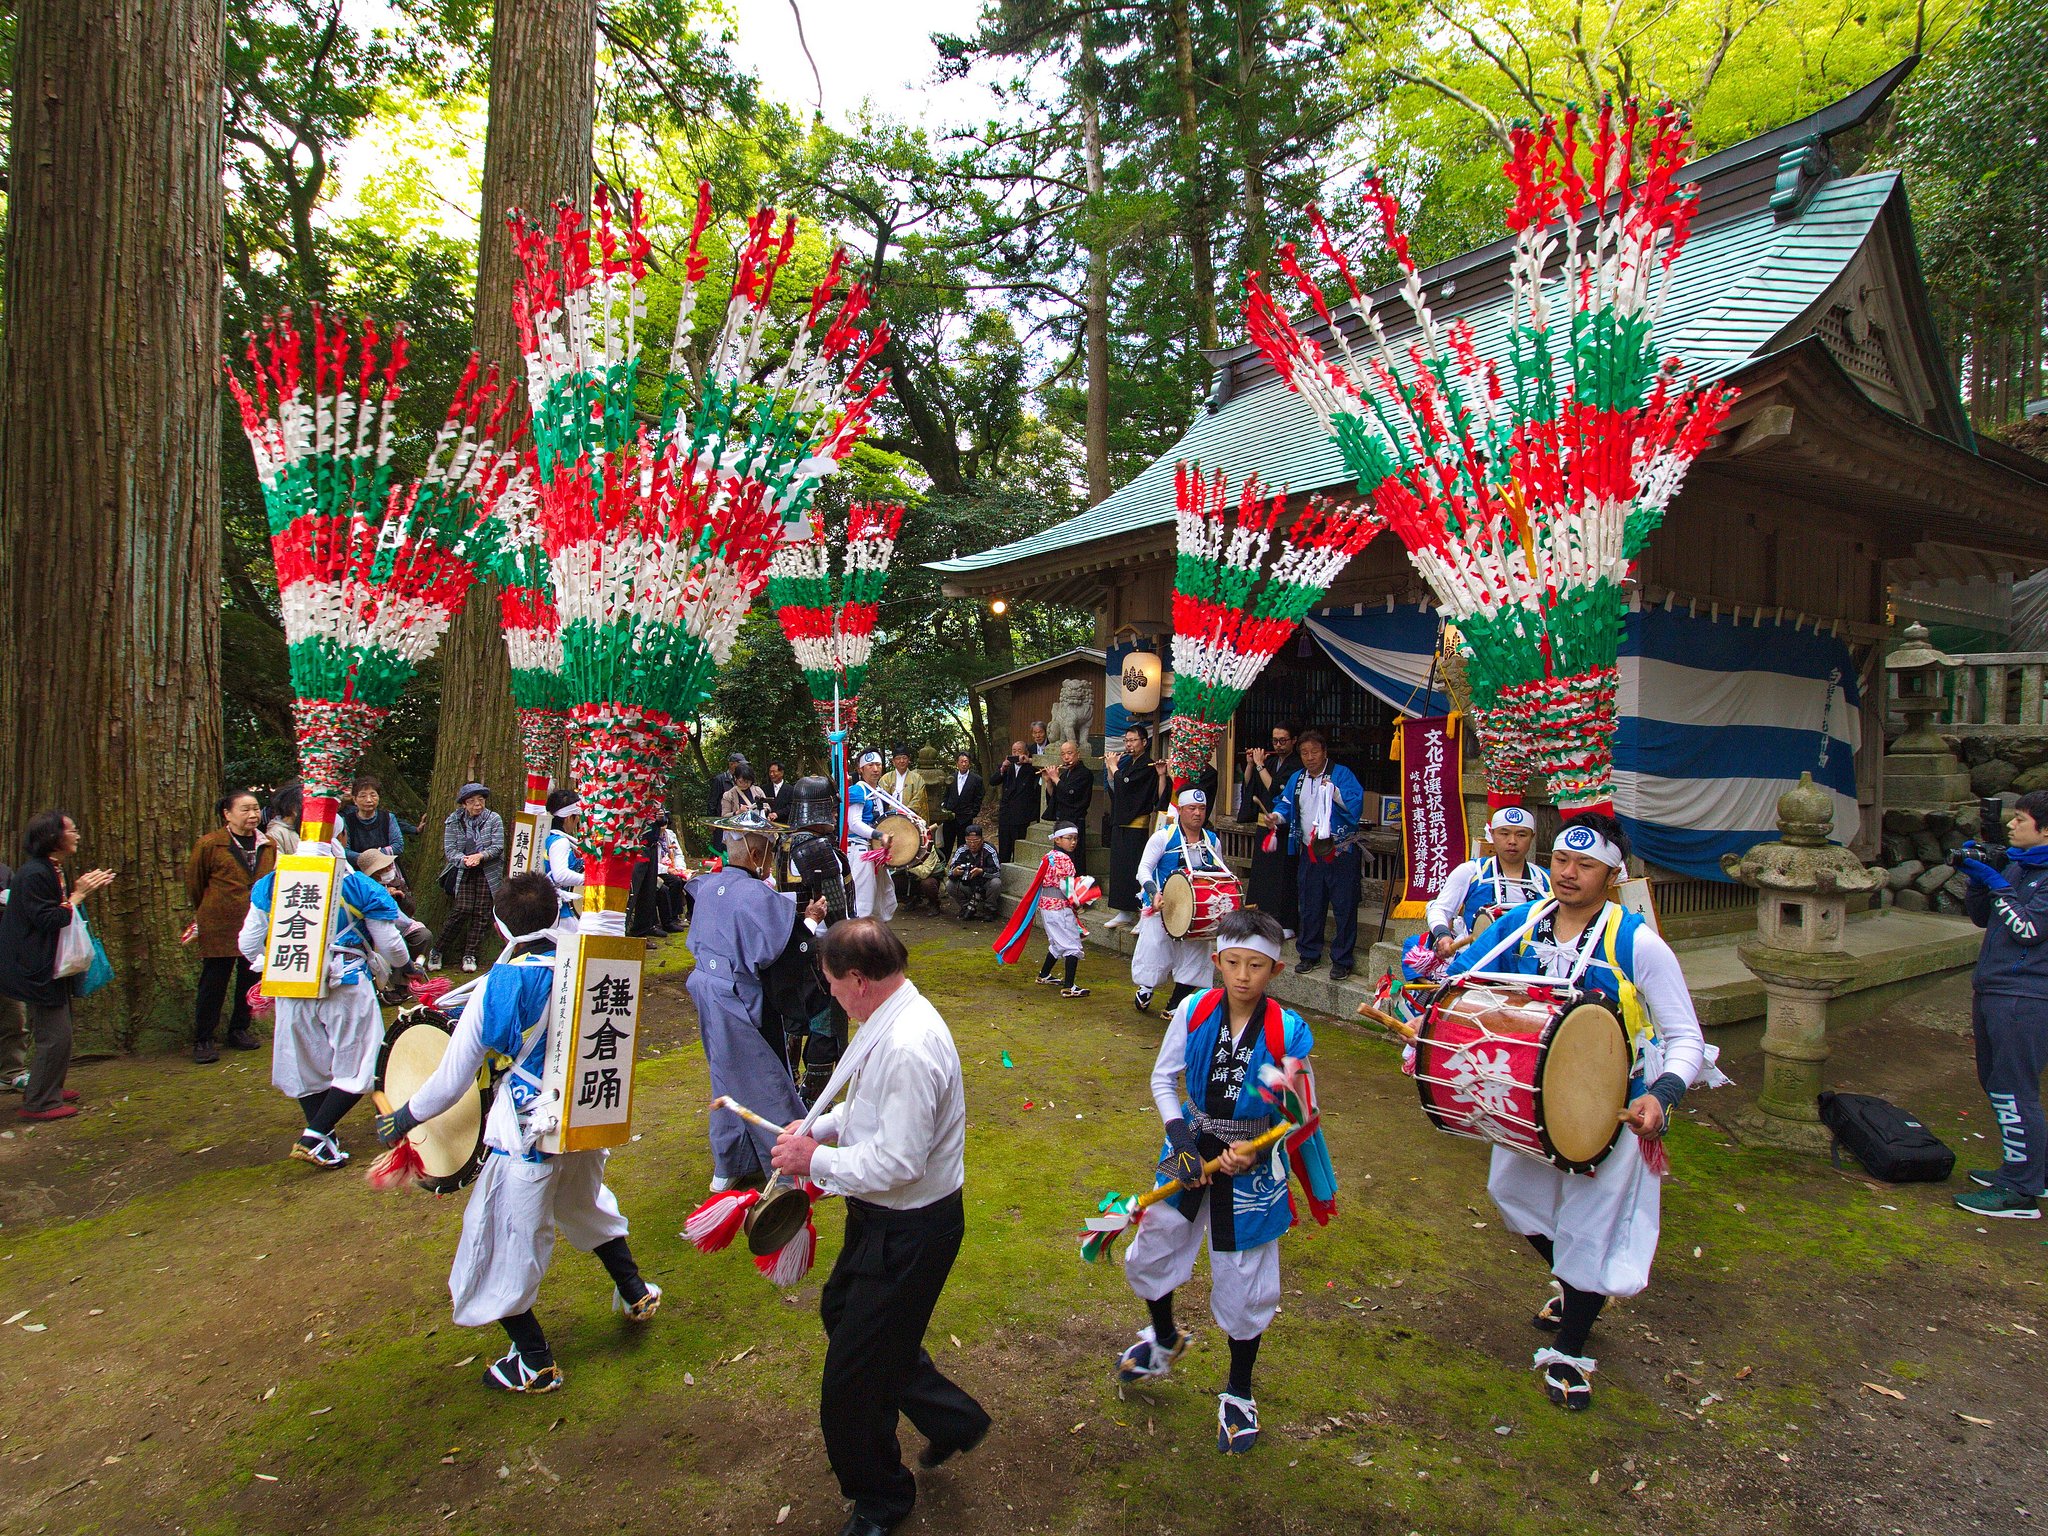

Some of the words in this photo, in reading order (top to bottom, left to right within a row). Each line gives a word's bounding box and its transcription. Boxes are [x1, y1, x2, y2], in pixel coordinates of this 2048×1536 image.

[1423, 729, 1449, 894] 文化庁選択無形文化財
[272, 881, 323, 973] 鎌倉踊
[577, 973, 634, 1110] 鎌倉踊
[1989, 1091, 2028, 1162] ITALIA
